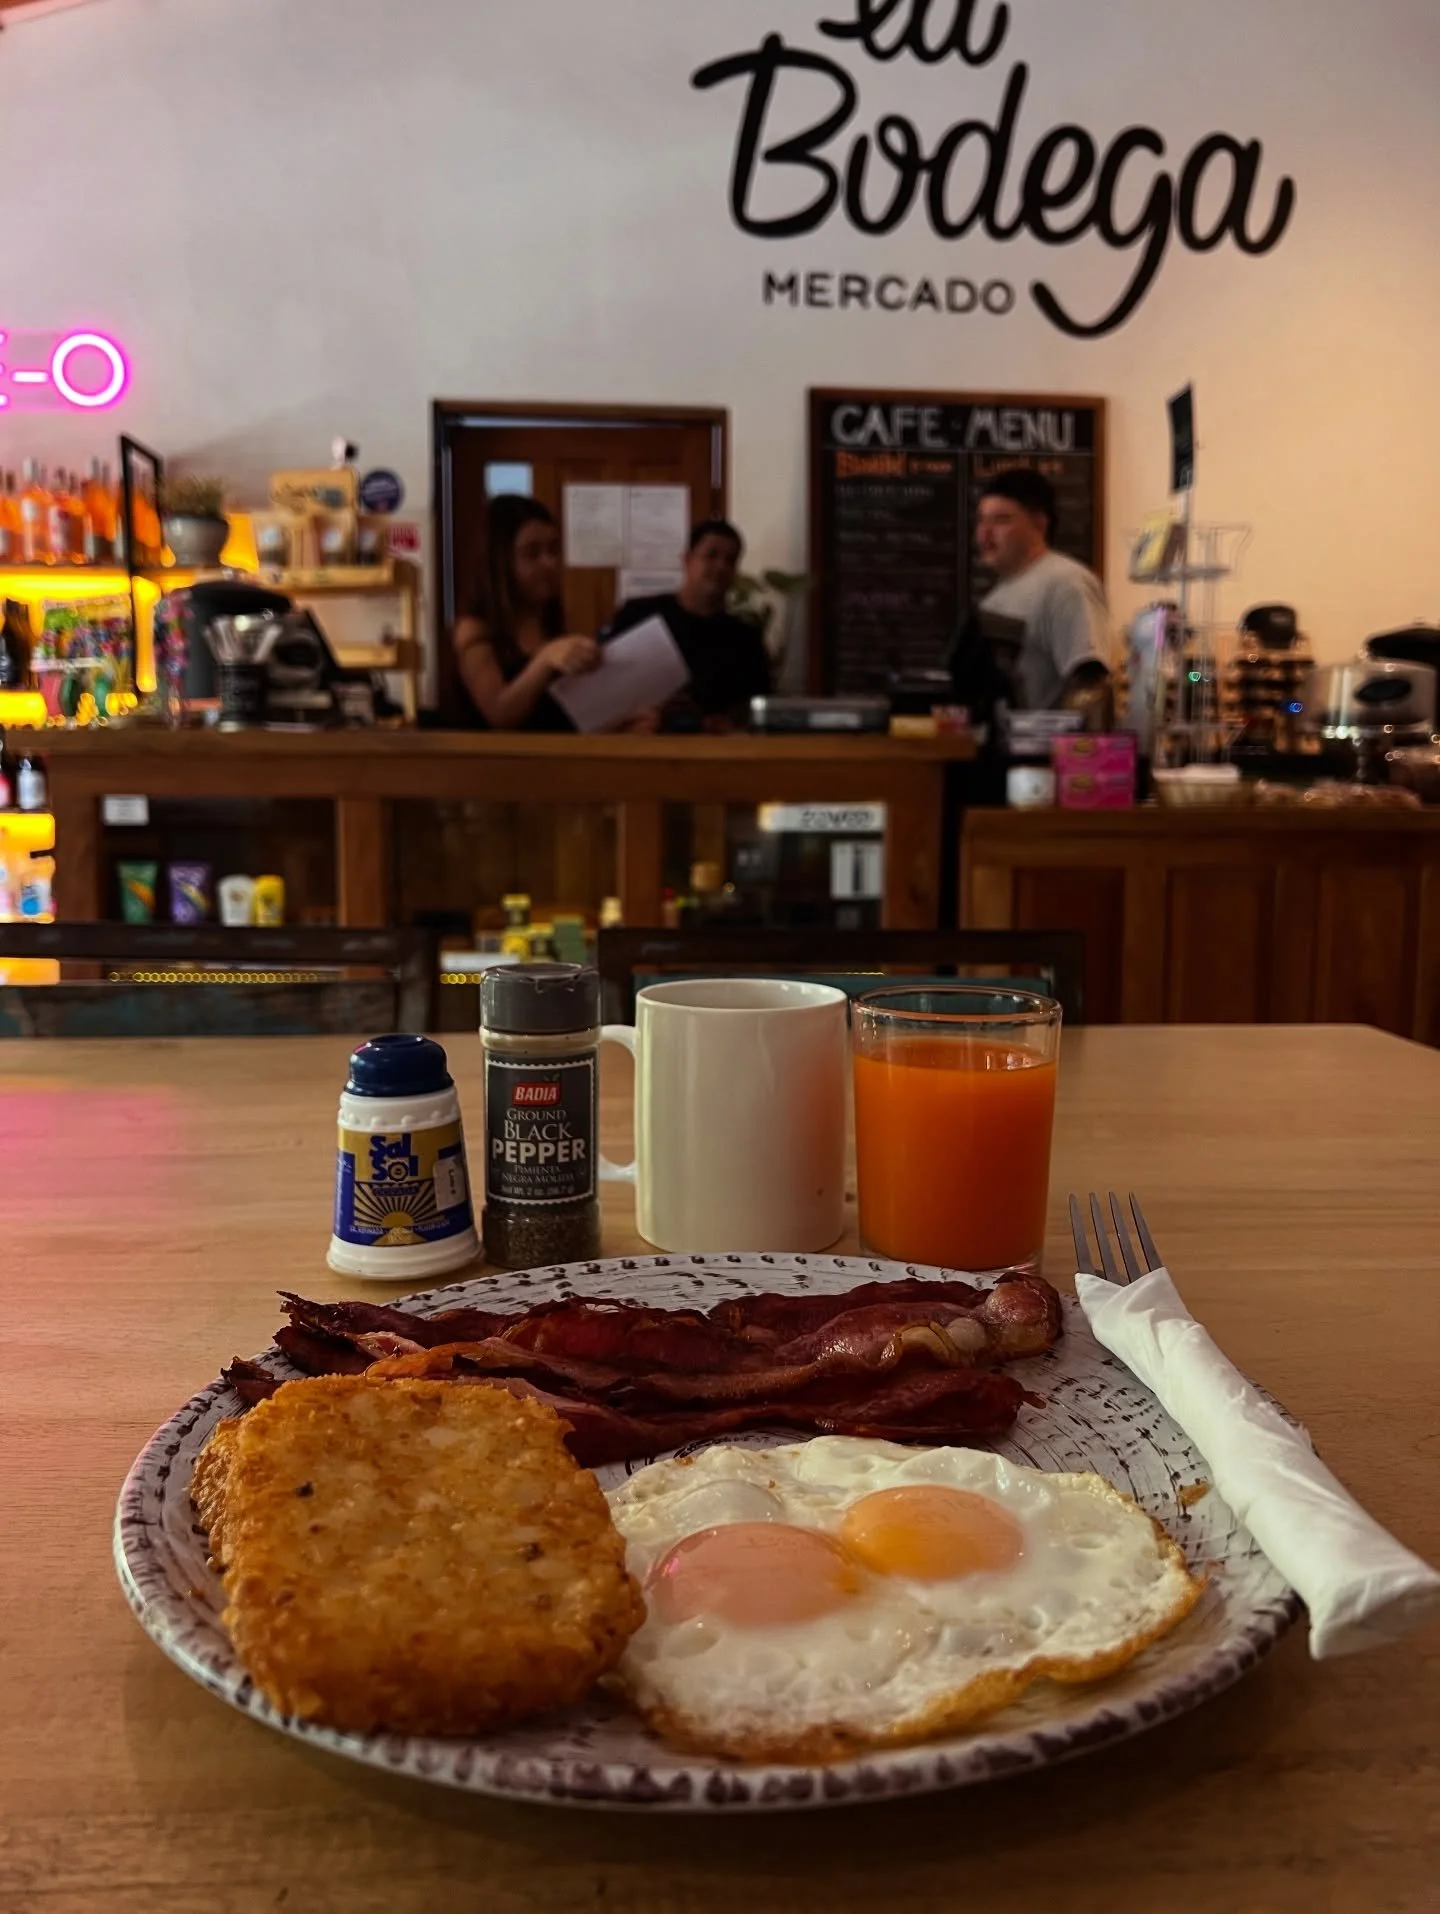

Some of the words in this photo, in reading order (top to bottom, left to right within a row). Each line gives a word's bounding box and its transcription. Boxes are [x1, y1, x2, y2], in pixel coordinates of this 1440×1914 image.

[690, 31, 1297, 339] Bodega
[762, 270, 1016, 315] MERCADO
[0, 332, 126, 407] -O
[831, 404, 947, 448] CAFE
[964, 406, 1076, 450] MENU
[514, 1086, 557, 1102] BADIA
[506, 1107, 567, 1121] GROUND
[503, 1120, 574, 1141] BLACK
[368, 1133, 412, 1158] Sal
[491, 1137, 587, 1165] PEPPER
[370, 1155, 419, 1182] Sol
